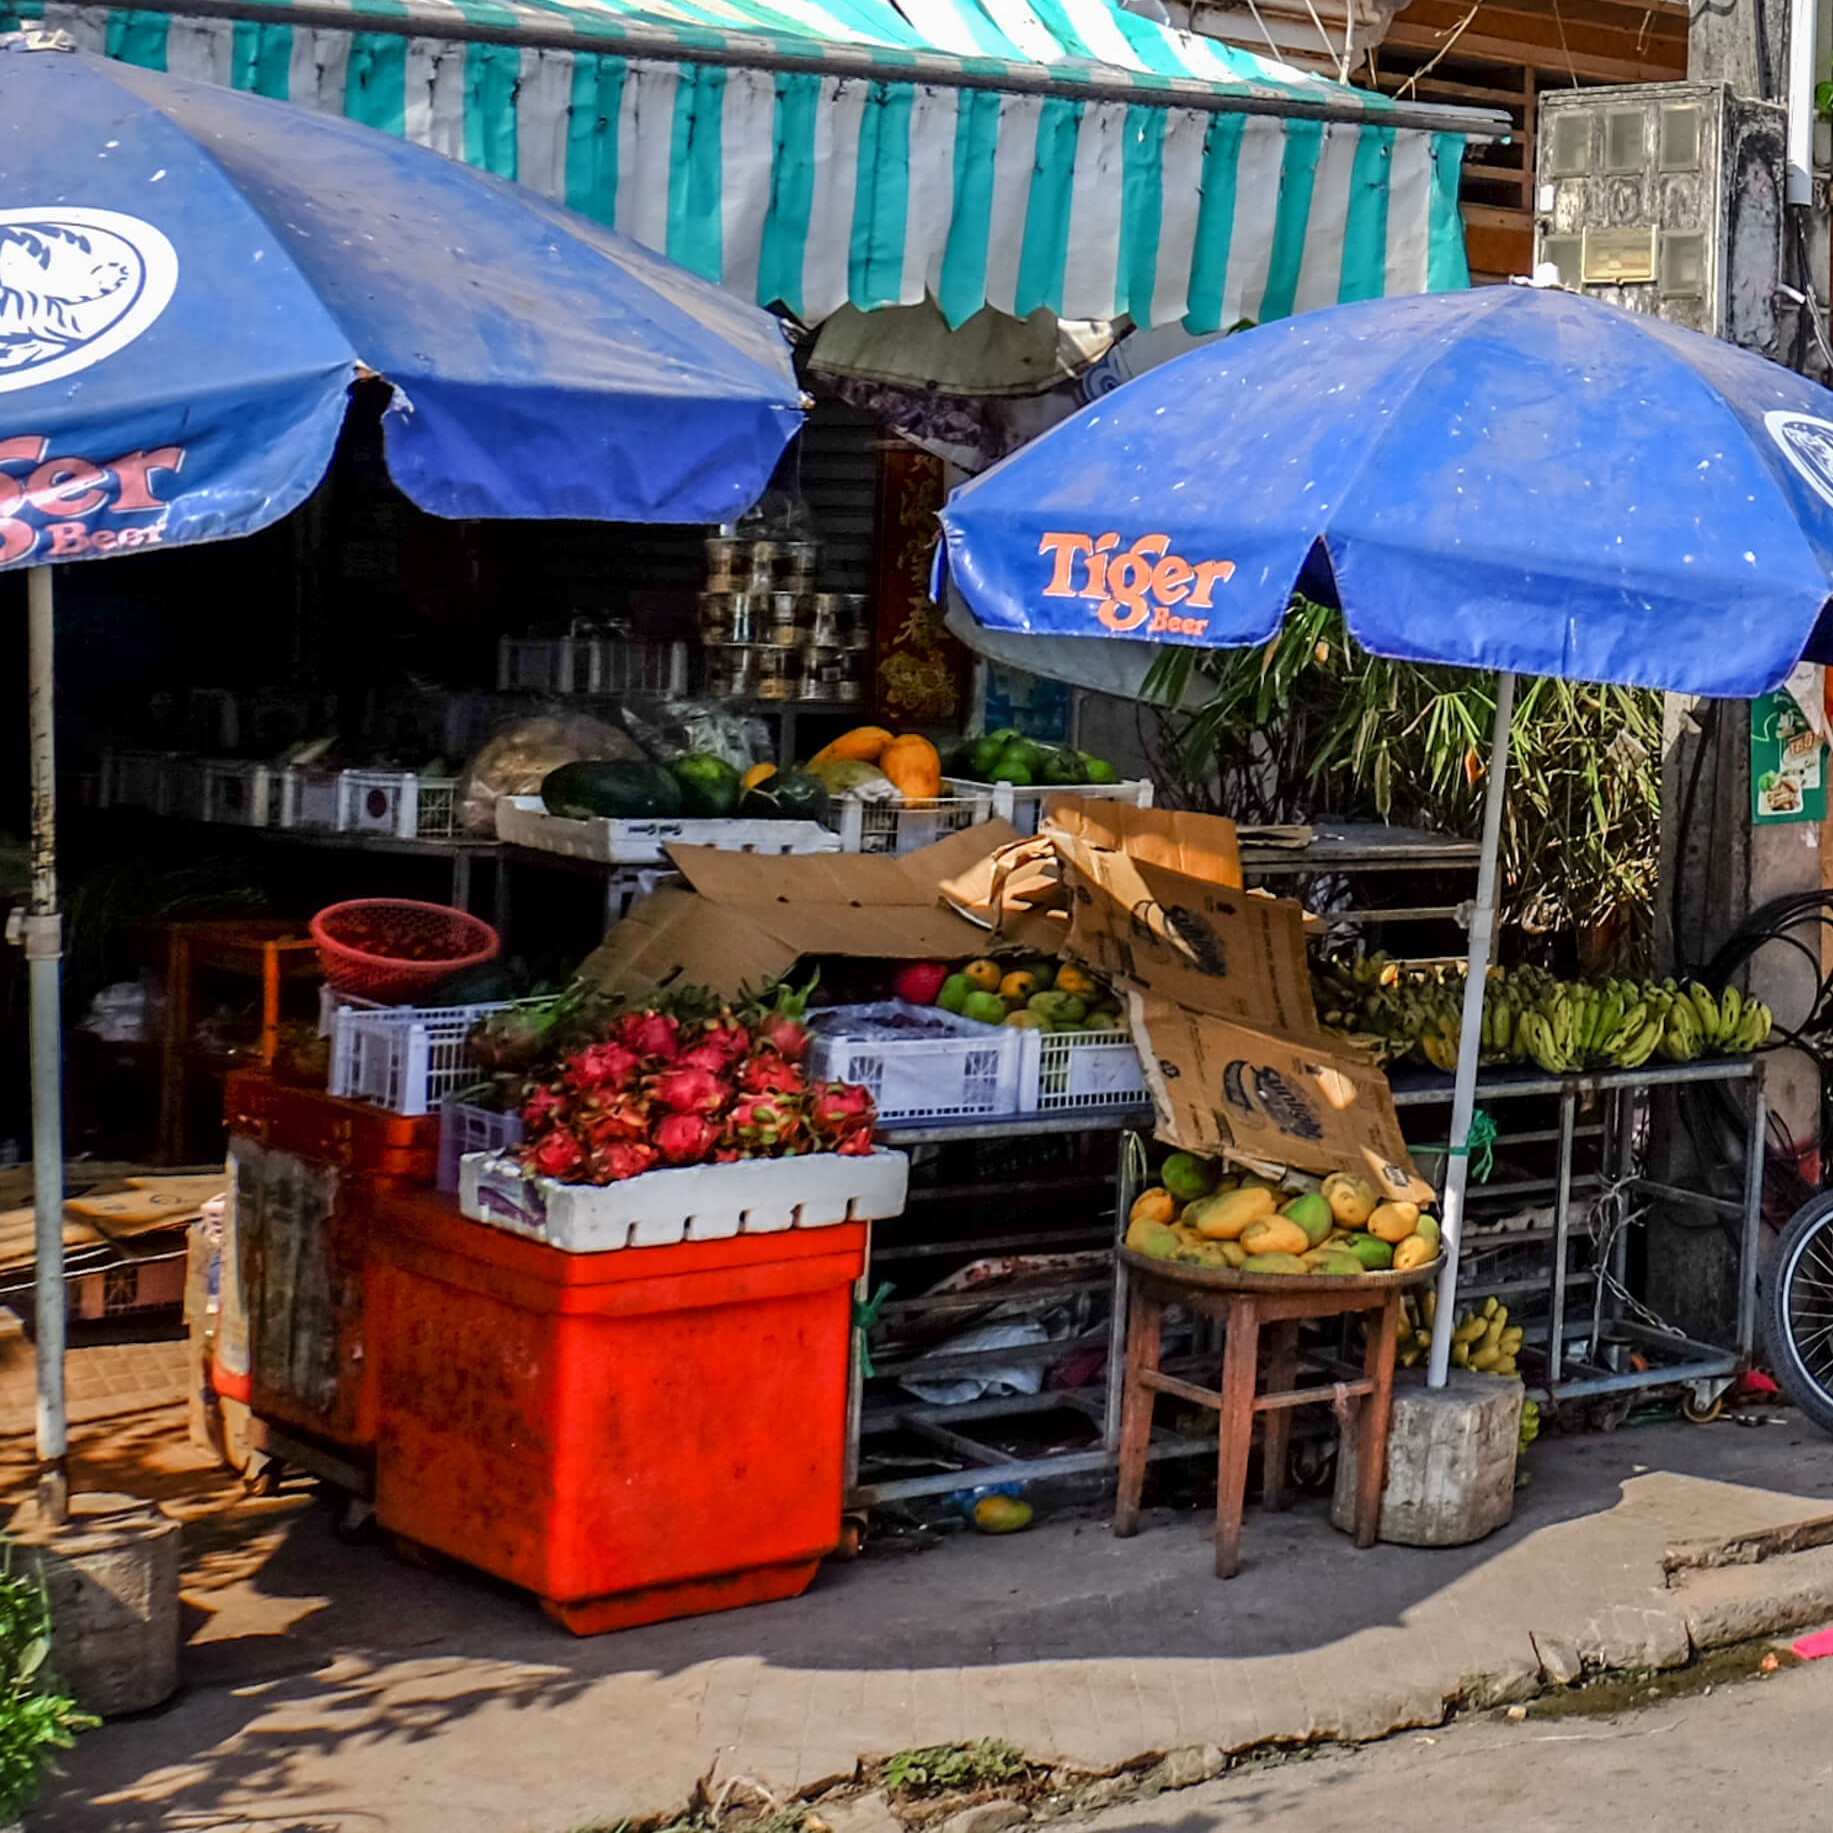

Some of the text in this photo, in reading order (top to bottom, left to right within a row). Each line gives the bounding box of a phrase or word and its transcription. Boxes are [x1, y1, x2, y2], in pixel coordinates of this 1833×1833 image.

[45, 520, 167, 555] Beer
[1038, 531, 1236, 631] Tiger
[1147, 606, 1209, 636] Beer
